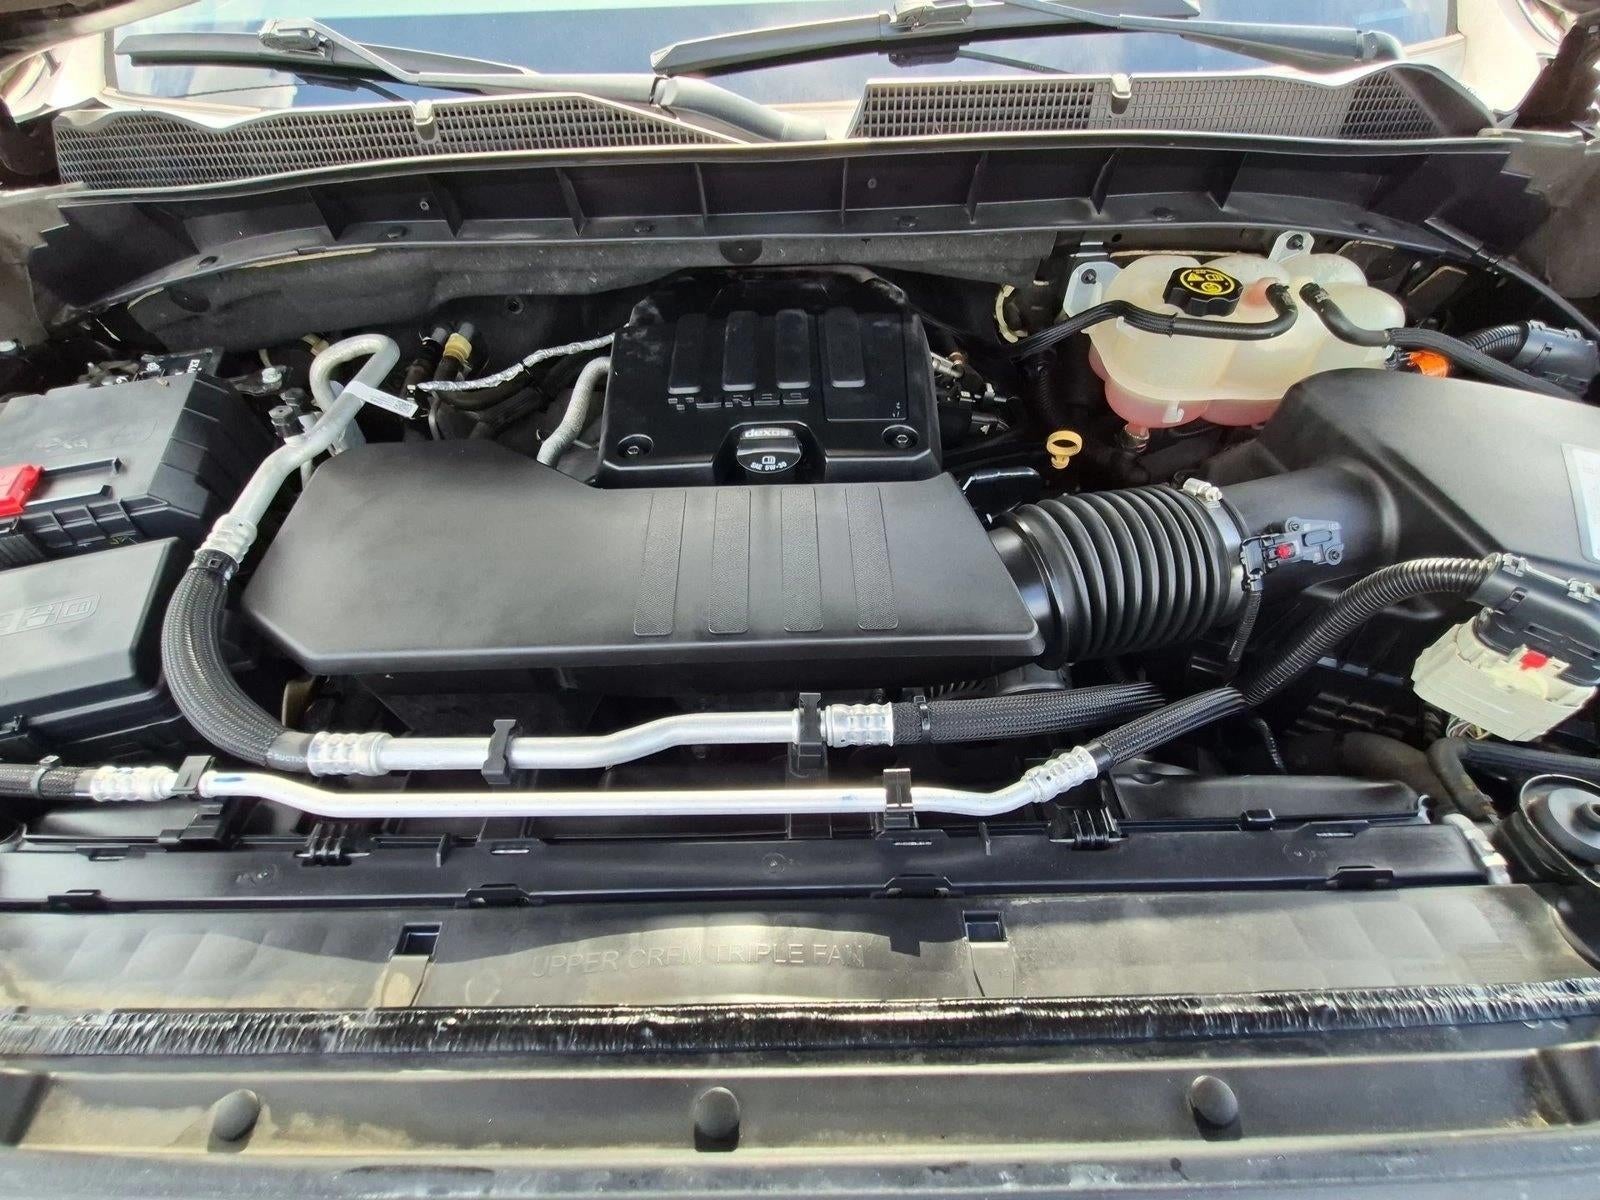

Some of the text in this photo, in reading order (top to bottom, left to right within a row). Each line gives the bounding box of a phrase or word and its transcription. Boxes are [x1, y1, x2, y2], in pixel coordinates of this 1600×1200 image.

[744, 428, 790, 438] dexos
[531, 950, 619, 977] UPPER
[711, 943, 805, 965] TRIPLE
[812, 943, 865, 968] FAN
